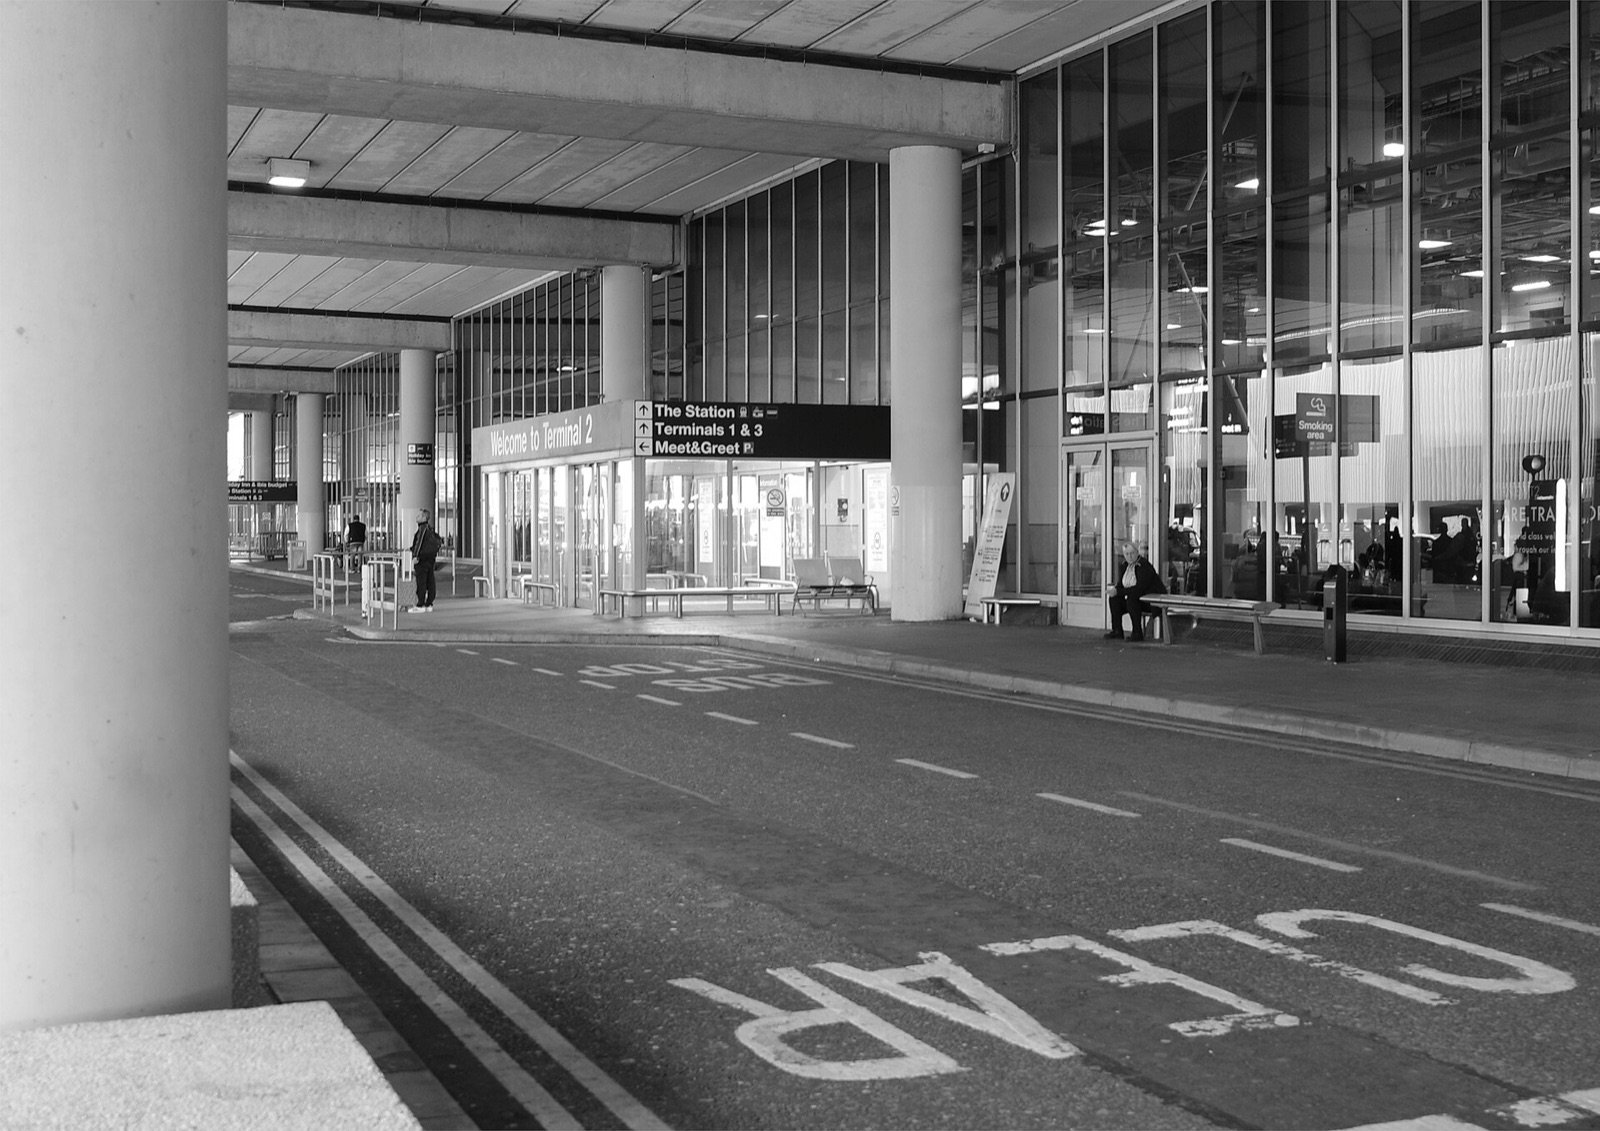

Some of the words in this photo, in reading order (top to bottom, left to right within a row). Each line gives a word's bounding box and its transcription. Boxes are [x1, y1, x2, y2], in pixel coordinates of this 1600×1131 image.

[655, 404, 682, 418] The
[685, 404, 735, 418] Station
[655, 422, 725, 436] Terminals
[728, 424, 736, 436] 1
[740, 424, 751, 436] &
[754, 424, 764, 436] 3
[1298, 420, 1333, 432] Smoking
[490, 430, 527, 457] Welcome
[530, 425, 540, 451] to
[543, 415, 582, 449] Terminal
[585, 413, 593, 444] 2
[1306, 432, 1324, 440] area
[655, 440, 740, 454] Meet&Greet
[651, 672, 834, 692] BUS
[668, 908, 1577, 1081] CLEAR
